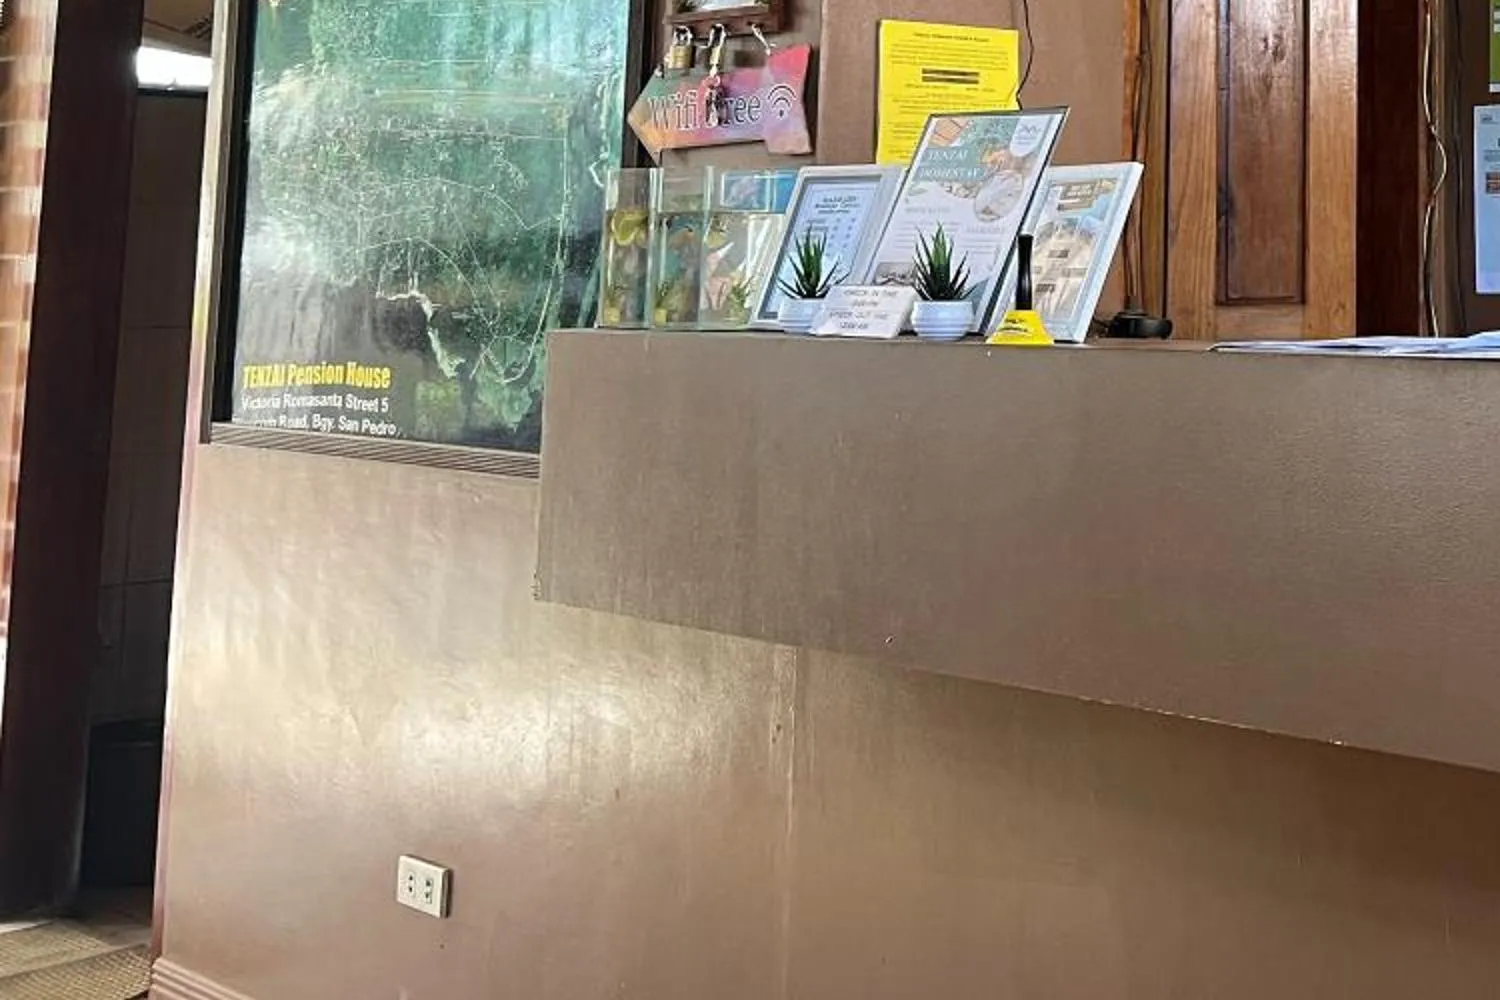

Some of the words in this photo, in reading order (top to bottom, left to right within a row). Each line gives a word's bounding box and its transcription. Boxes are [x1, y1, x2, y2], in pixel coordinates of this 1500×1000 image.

[243, 363, 285, 389] TENZAI
[287, 361, 344, 386] Pension
[345, 361, 391, 389] House
[345, 394, 379, 413] Street
[381, 397, 389, 413] 5
[338, 415, 359, 433] San
